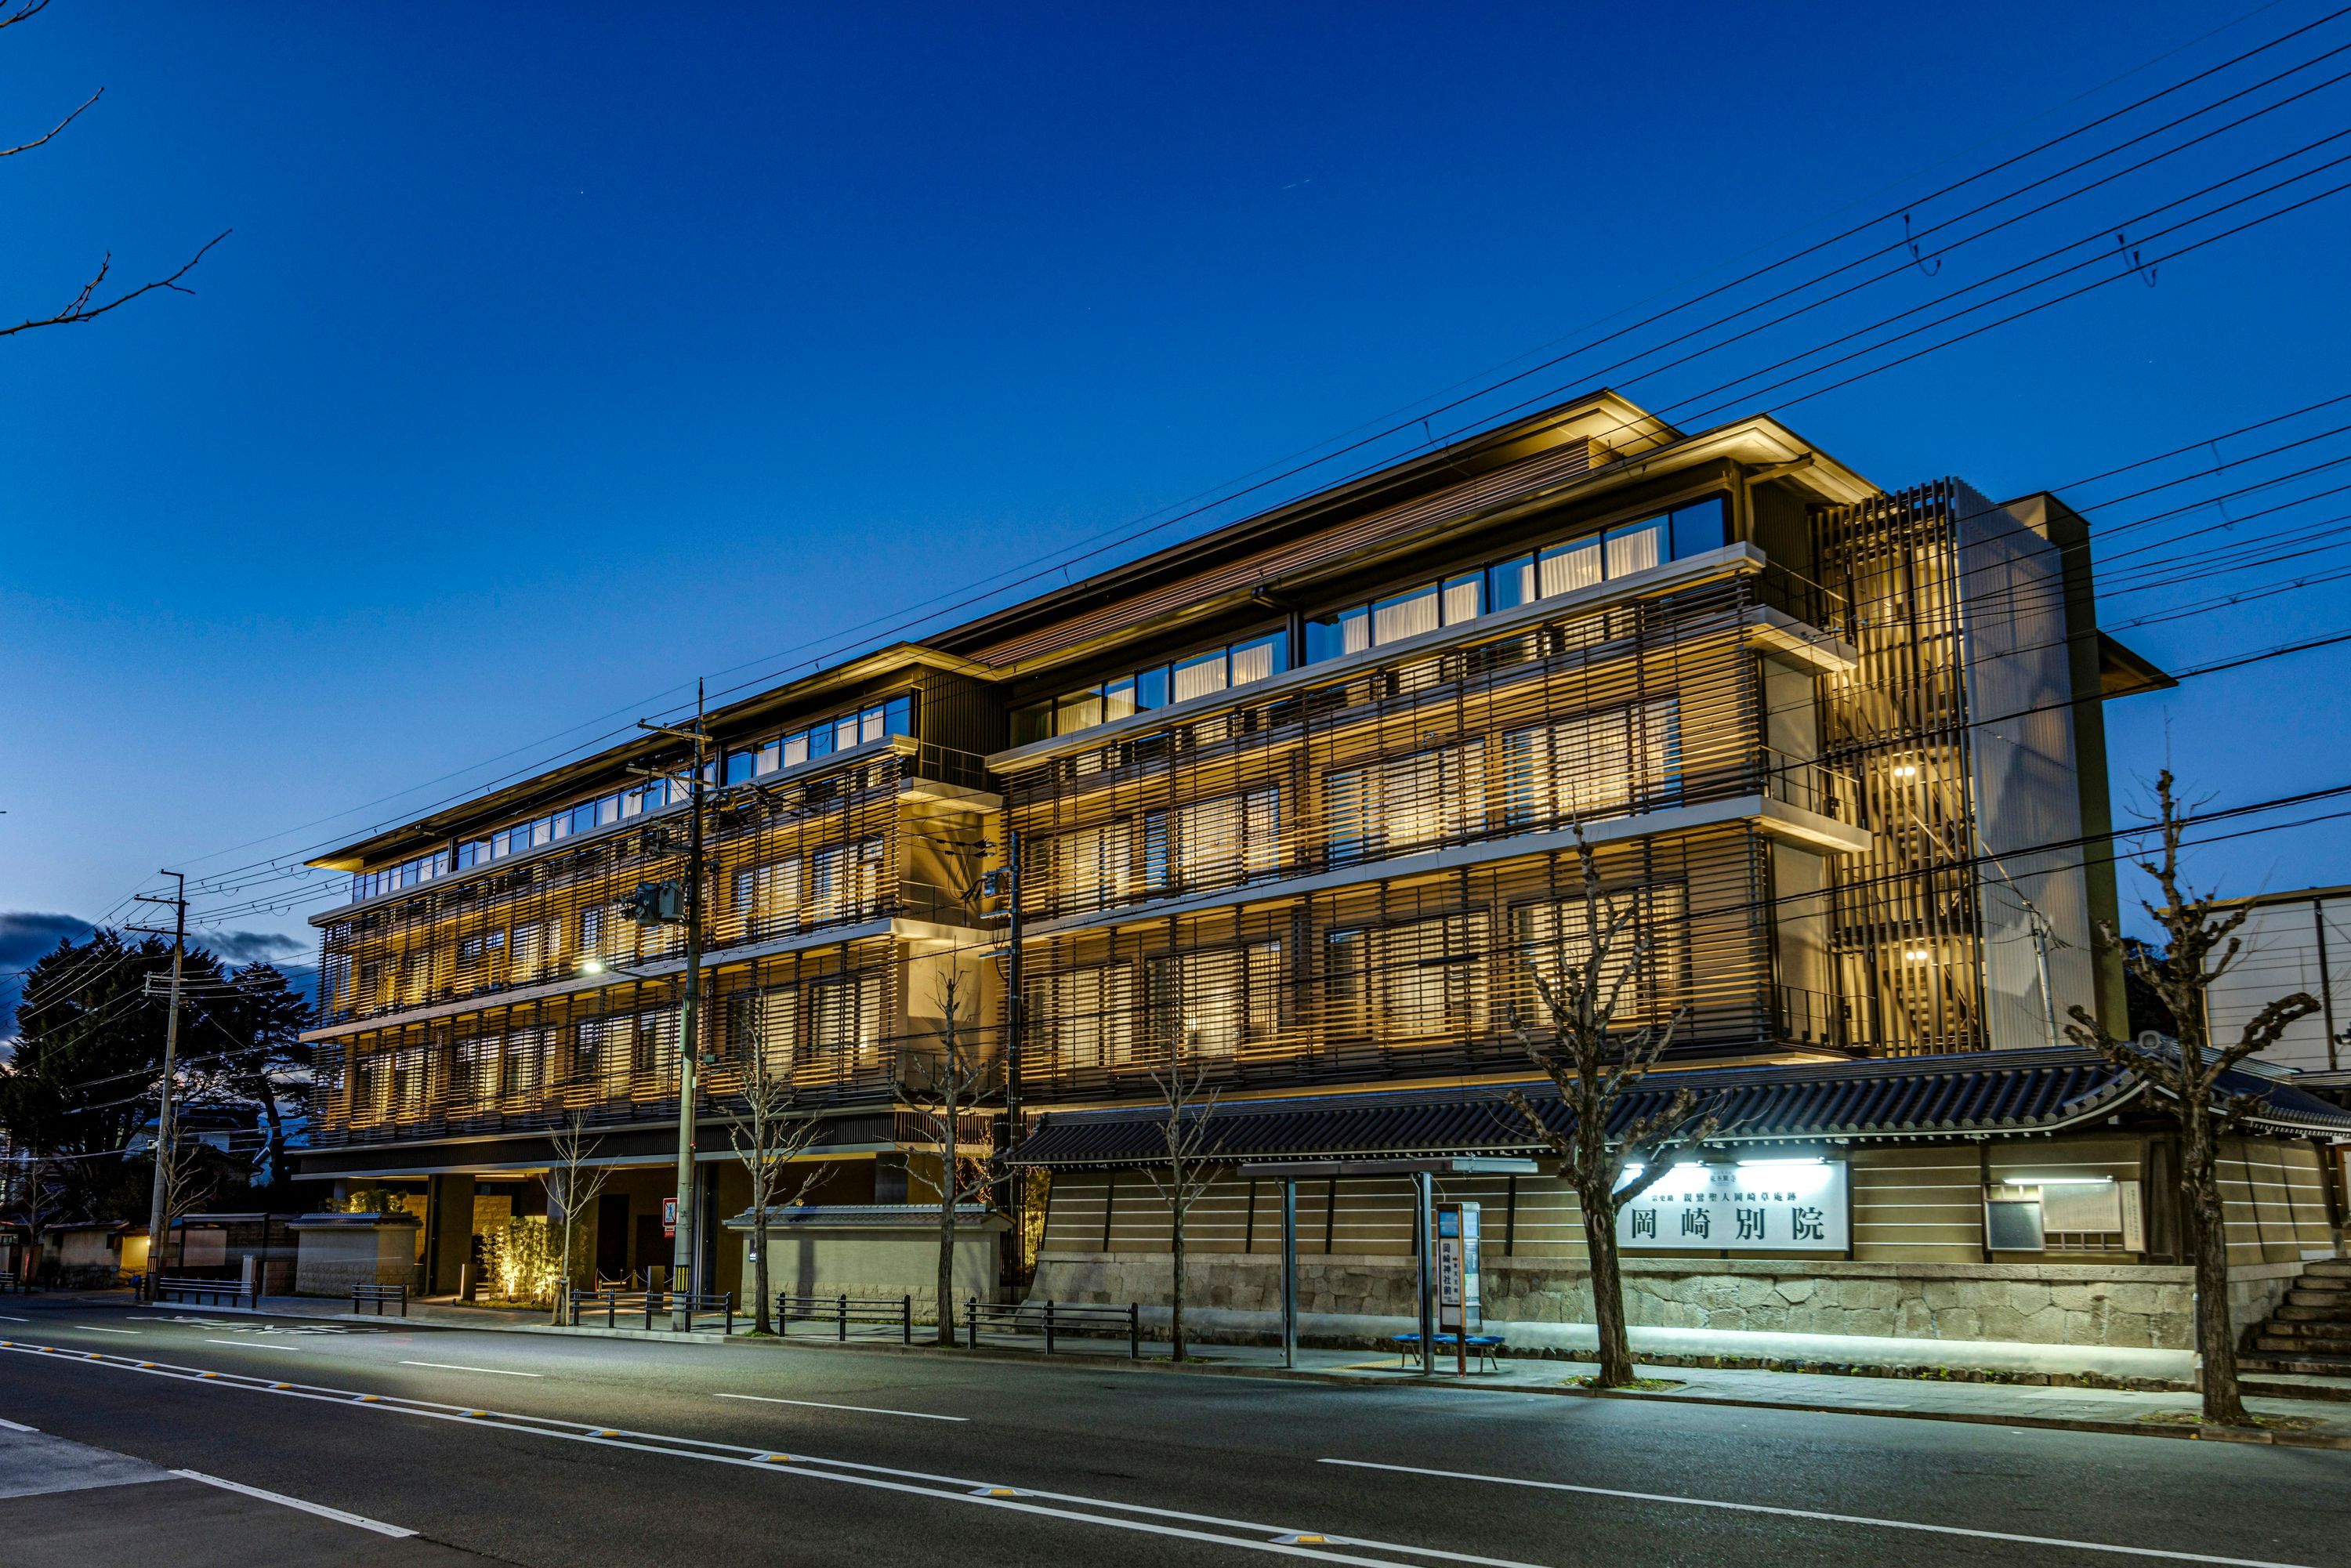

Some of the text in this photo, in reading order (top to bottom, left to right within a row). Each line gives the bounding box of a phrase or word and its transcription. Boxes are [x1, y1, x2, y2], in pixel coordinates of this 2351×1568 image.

[1632, 1207, 1824, 1240] 岡崎別院
[1443, 1243, 1451, 1295] 岡崎神社前
